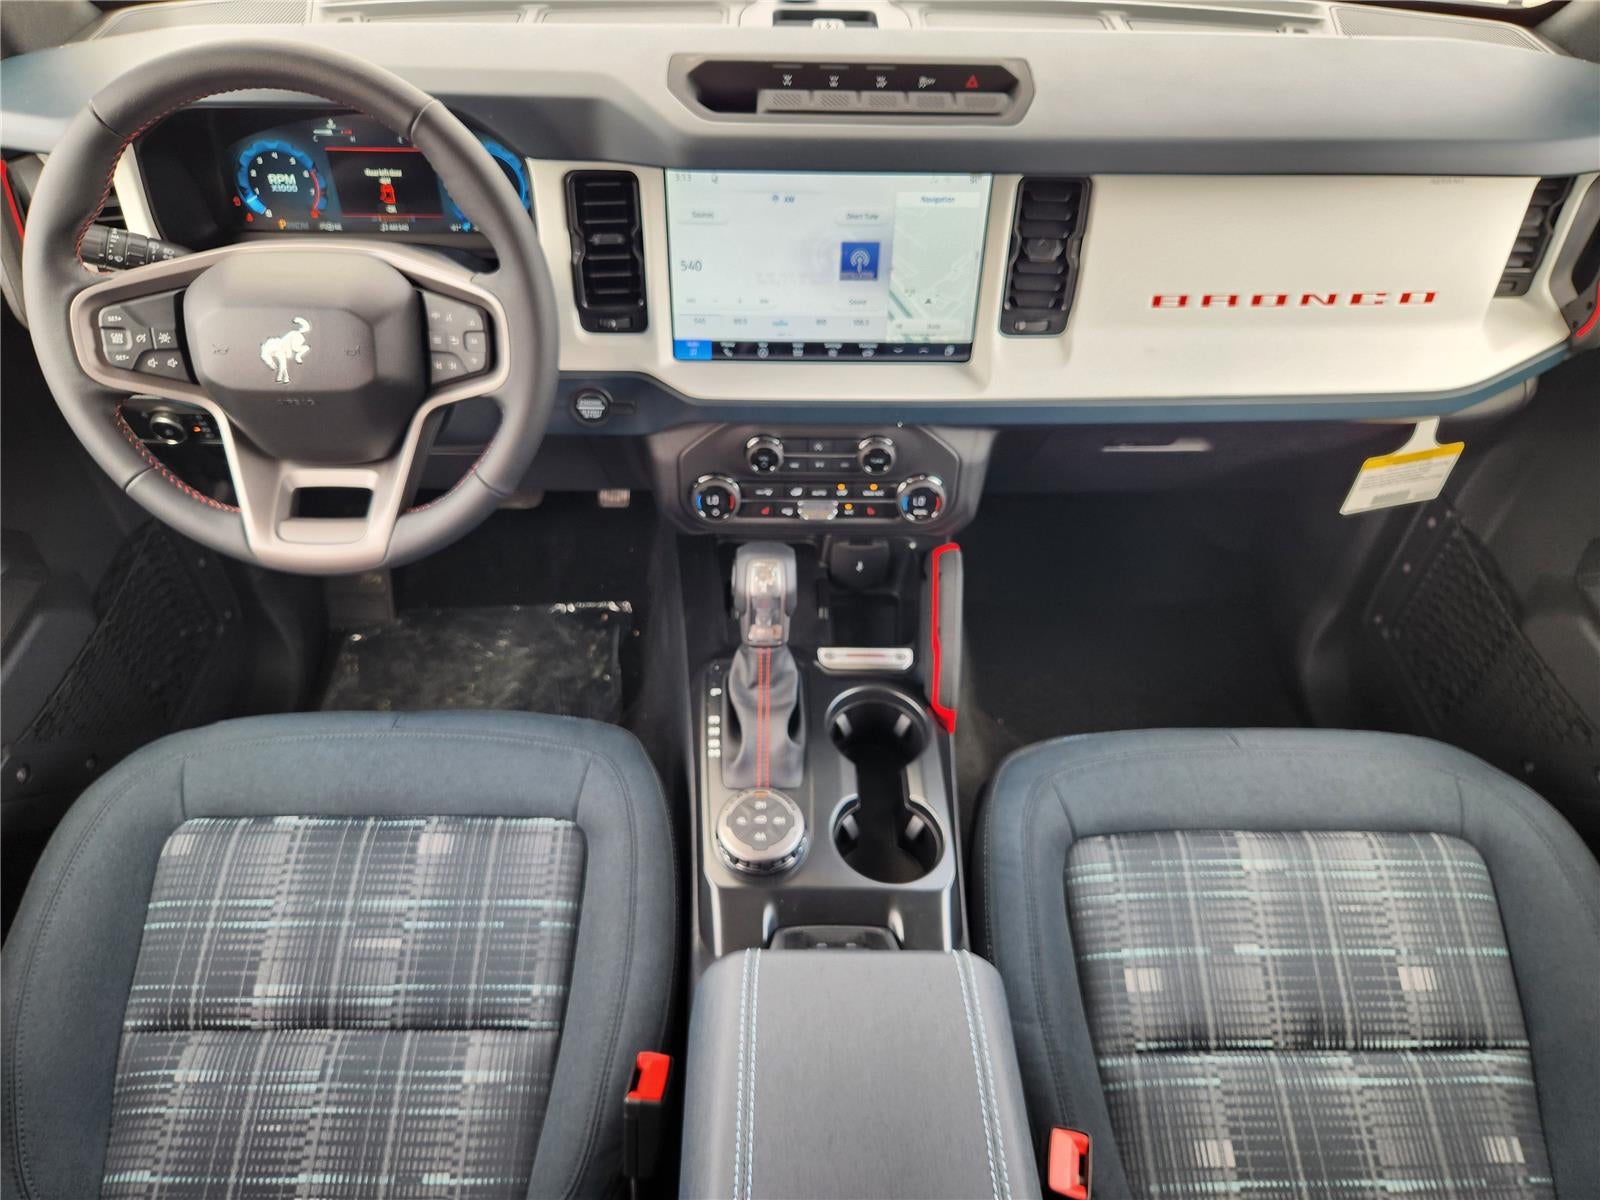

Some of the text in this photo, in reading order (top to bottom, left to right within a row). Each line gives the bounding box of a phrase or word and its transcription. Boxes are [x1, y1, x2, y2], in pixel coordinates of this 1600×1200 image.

[267, 173, 297, 185] RPM
[680, 260, 703, 272] 540
[1151, 291, 1437, 308] BRONCO
[912, 495, 927, 507] LO
